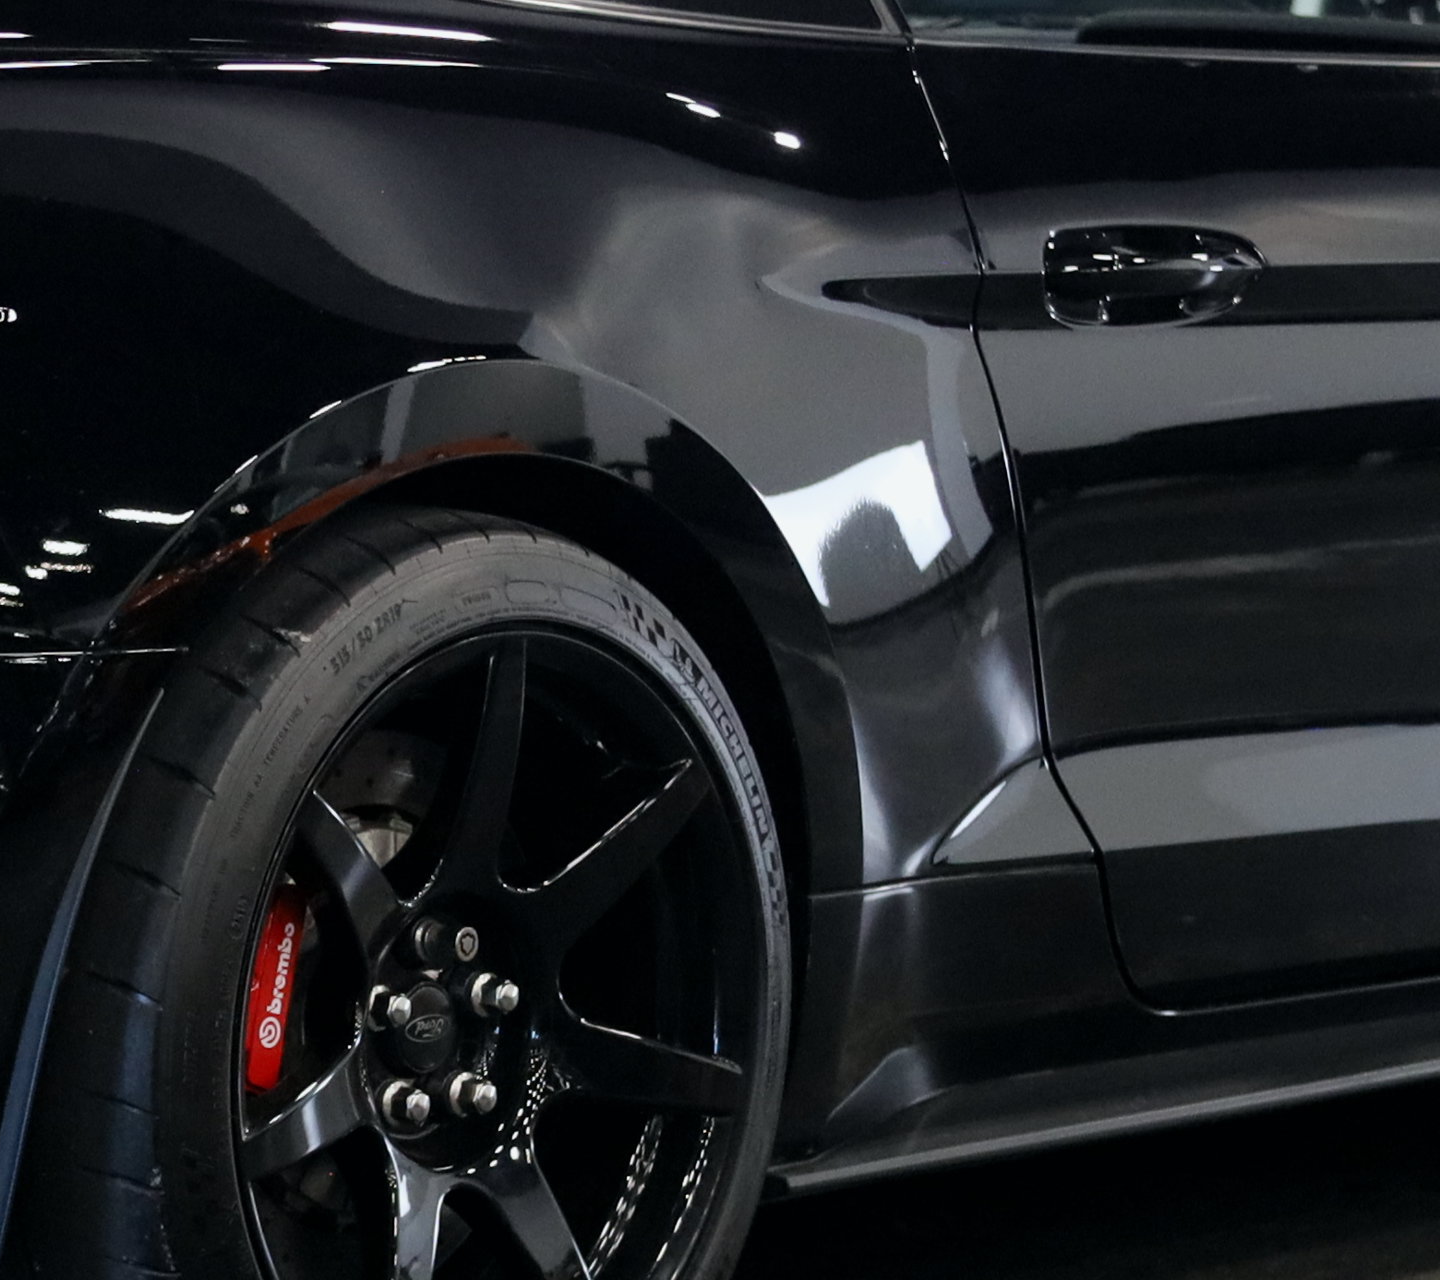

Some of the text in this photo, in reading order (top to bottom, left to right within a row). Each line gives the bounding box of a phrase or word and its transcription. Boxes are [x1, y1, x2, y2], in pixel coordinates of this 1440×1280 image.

[696, 677, 770, 835] MICHELIN
[266, 921, 295, 1014] brembo
[413, 1017, 444, 1037] Ford
